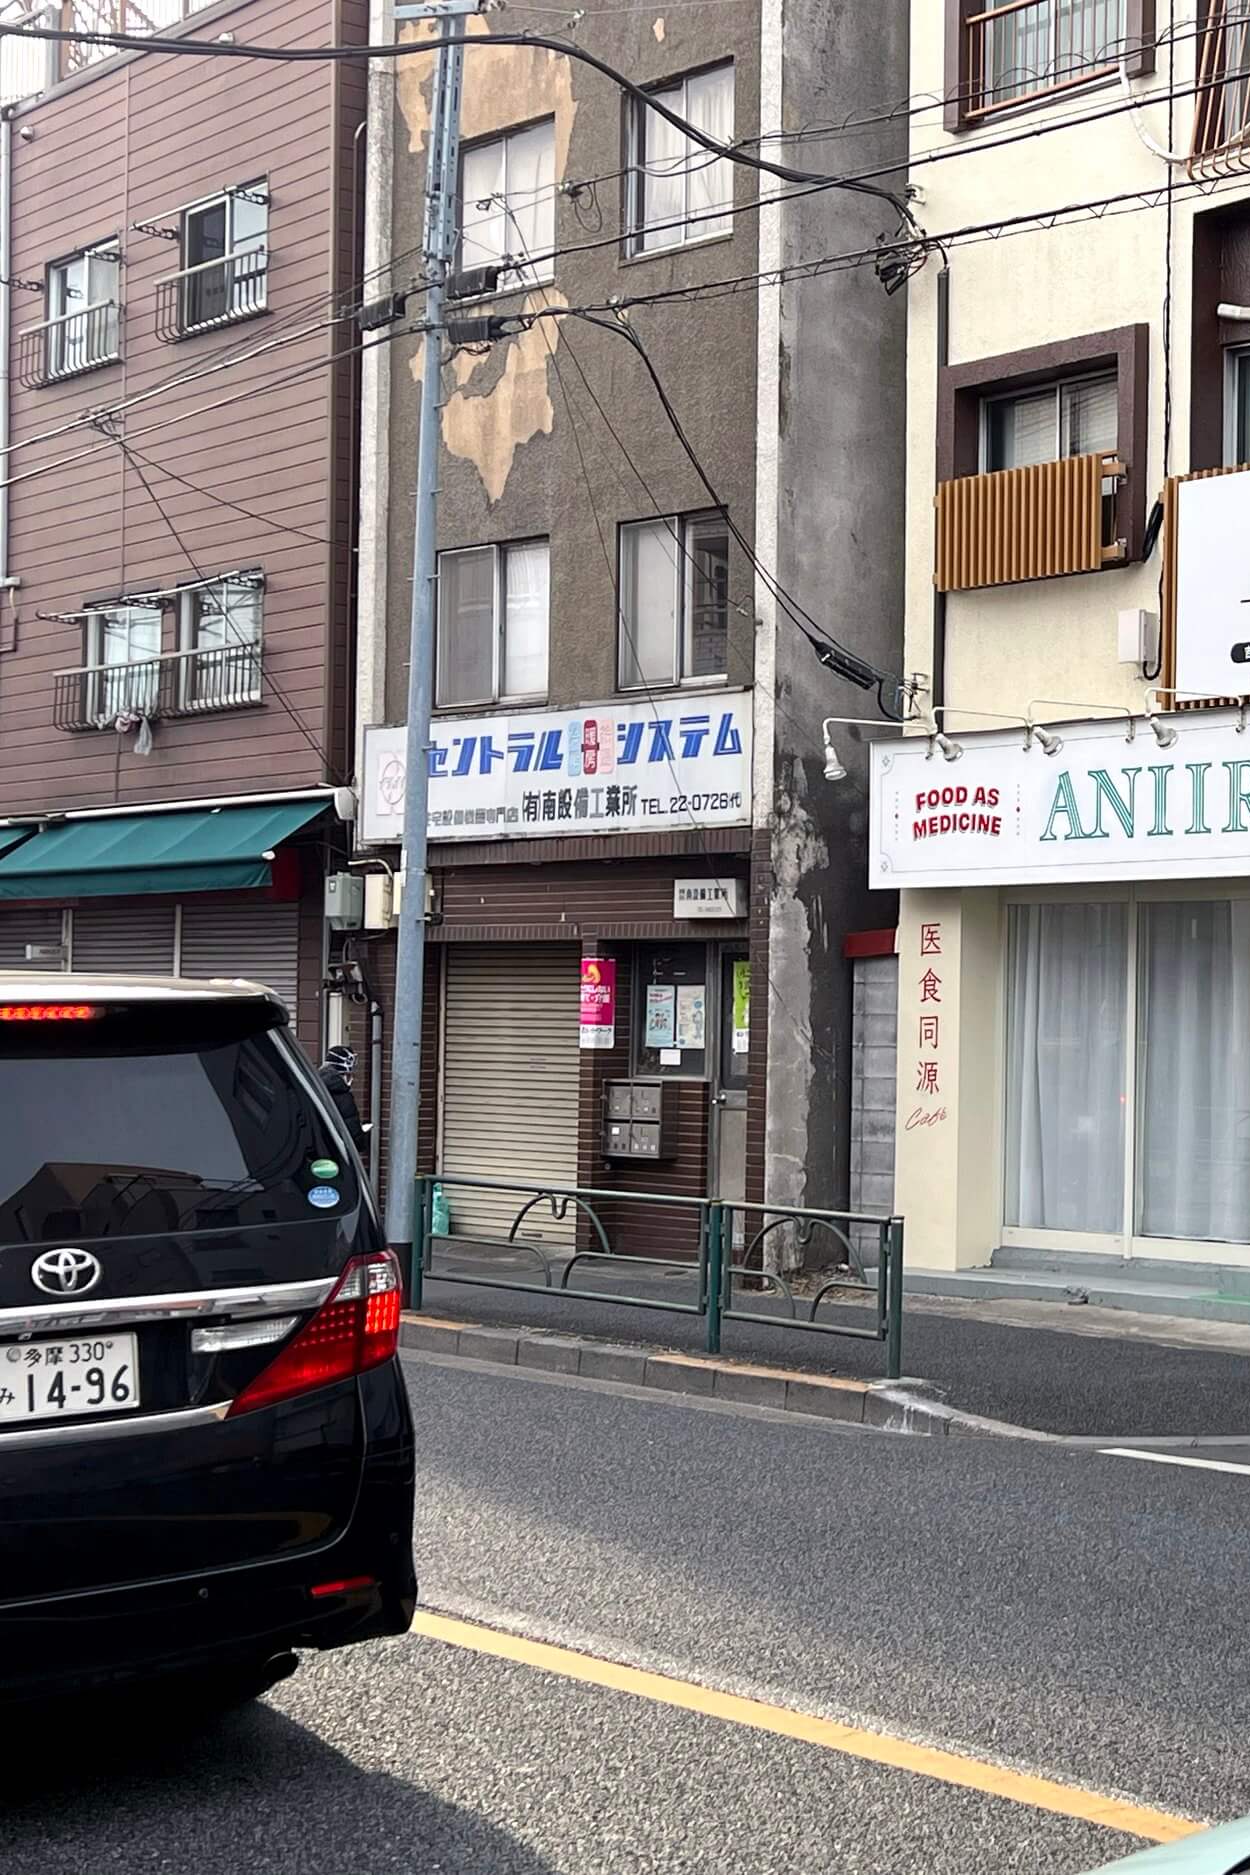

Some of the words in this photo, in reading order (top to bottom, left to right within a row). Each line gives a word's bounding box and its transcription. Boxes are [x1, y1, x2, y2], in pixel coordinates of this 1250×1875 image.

[426, 730, 564, 778] セントラル
[617, 713, 742, 765] システム
[916, 786, 968, 813] FOOD
[972, 786, 1000, 808] AS
[912, 813, 1002, 841] MEDICINE
[916, 922, 942, 1095] 医食同源
[24, 1346, 63, 1368] 多摩
[69, 1341, 105, 1363] 330
[27, 1364, 130, 1412] 14-96
